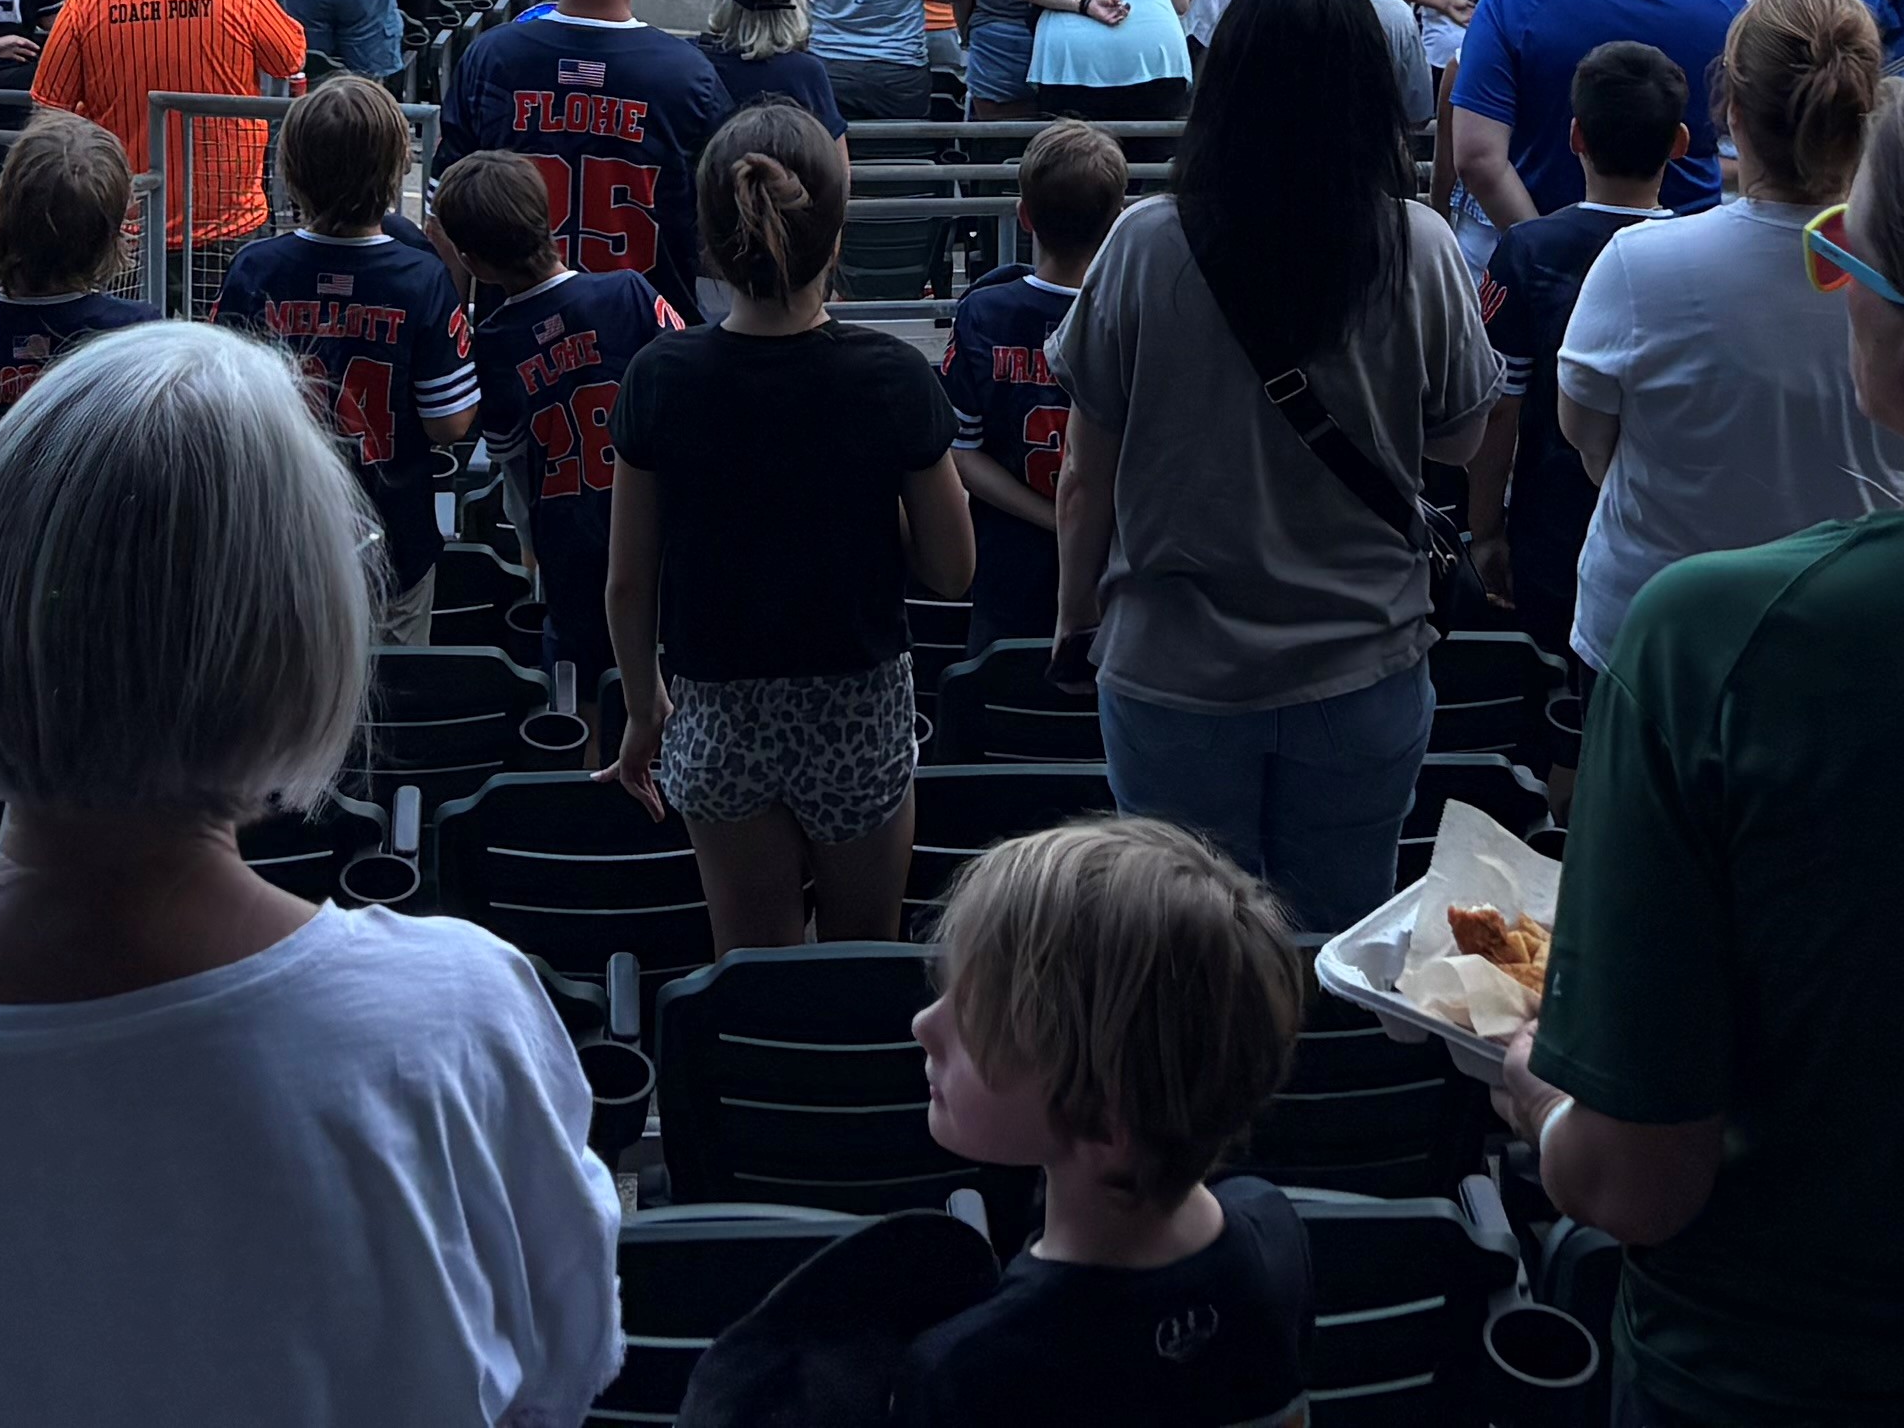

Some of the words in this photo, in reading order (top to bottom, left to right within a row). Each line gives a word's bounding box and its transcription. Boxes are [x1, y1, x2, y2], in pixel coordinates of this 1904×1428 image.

[109, 0, 161, 25] COACH
[513, 90, 648, 143] FLOHE
[265, 300, 406, 343] MELLOTT
[516, 330, 602, 395] FLOHE
